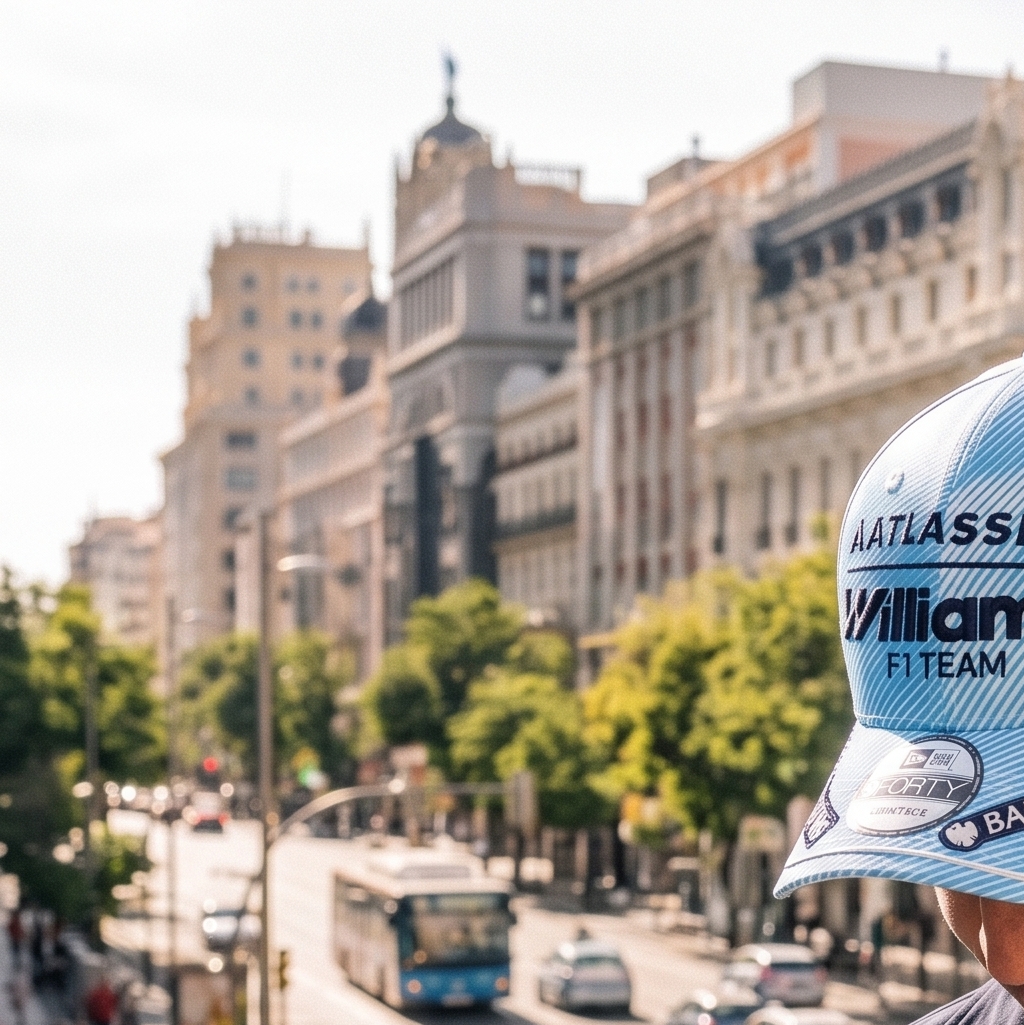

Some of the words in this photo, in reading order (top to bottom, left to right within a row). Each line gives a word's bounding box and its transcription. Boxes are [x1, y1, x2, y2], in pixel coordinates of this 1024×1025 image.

[887, 652, 911, 679] F1
[919, 650, 1007, 680] TEAM
[862, 777, 970, 799] FORTY
